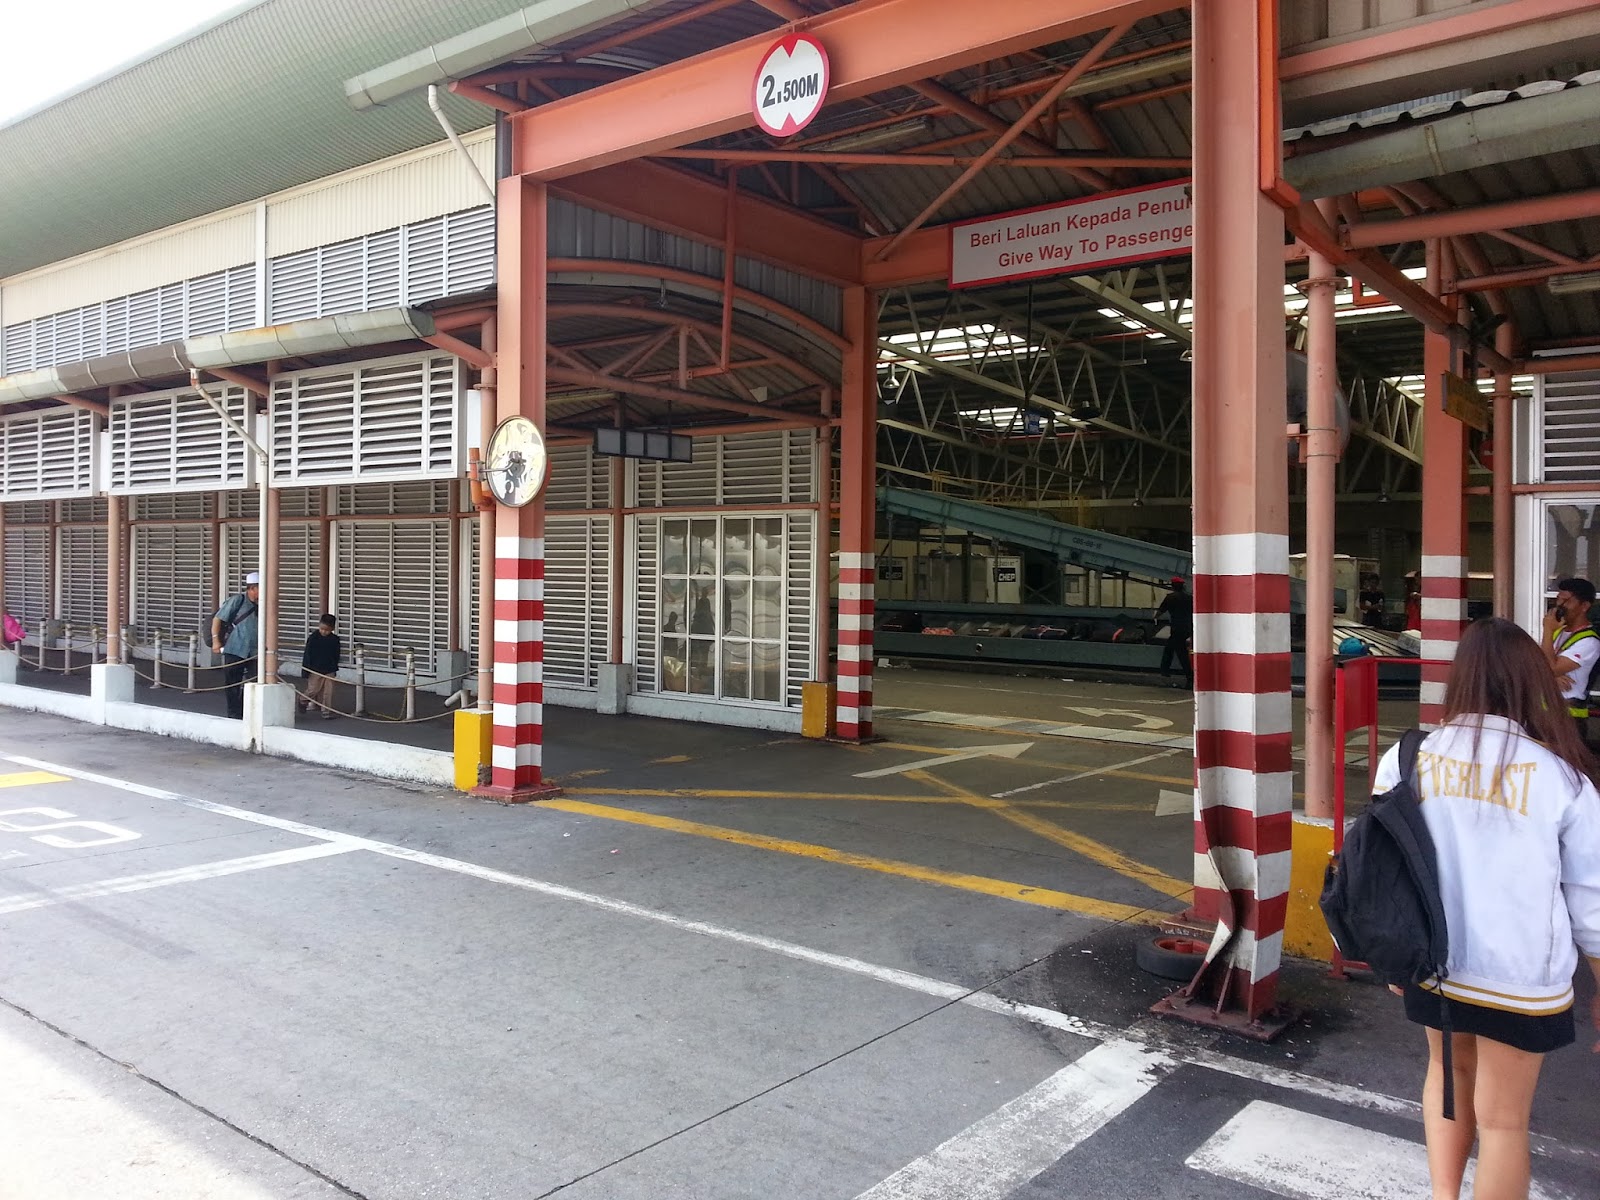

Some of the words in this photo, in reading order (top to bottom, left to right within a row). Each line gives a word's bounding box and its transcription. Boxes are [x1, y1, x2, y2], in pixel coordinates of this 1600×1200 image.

[970, 230, 1001, 247] Beri
[1007, 221, 1060, 241] Laluan
[1067, 206, 1131, 231] Kepada
[998, 250, 1033, 267] Give
[1039, 245, 1073, 261] Way
[1079, 239, 1099, 254] To
[1106, 224, 1192, 250] Passenge
[1417, 751, 1537, 817] EVERLAST
